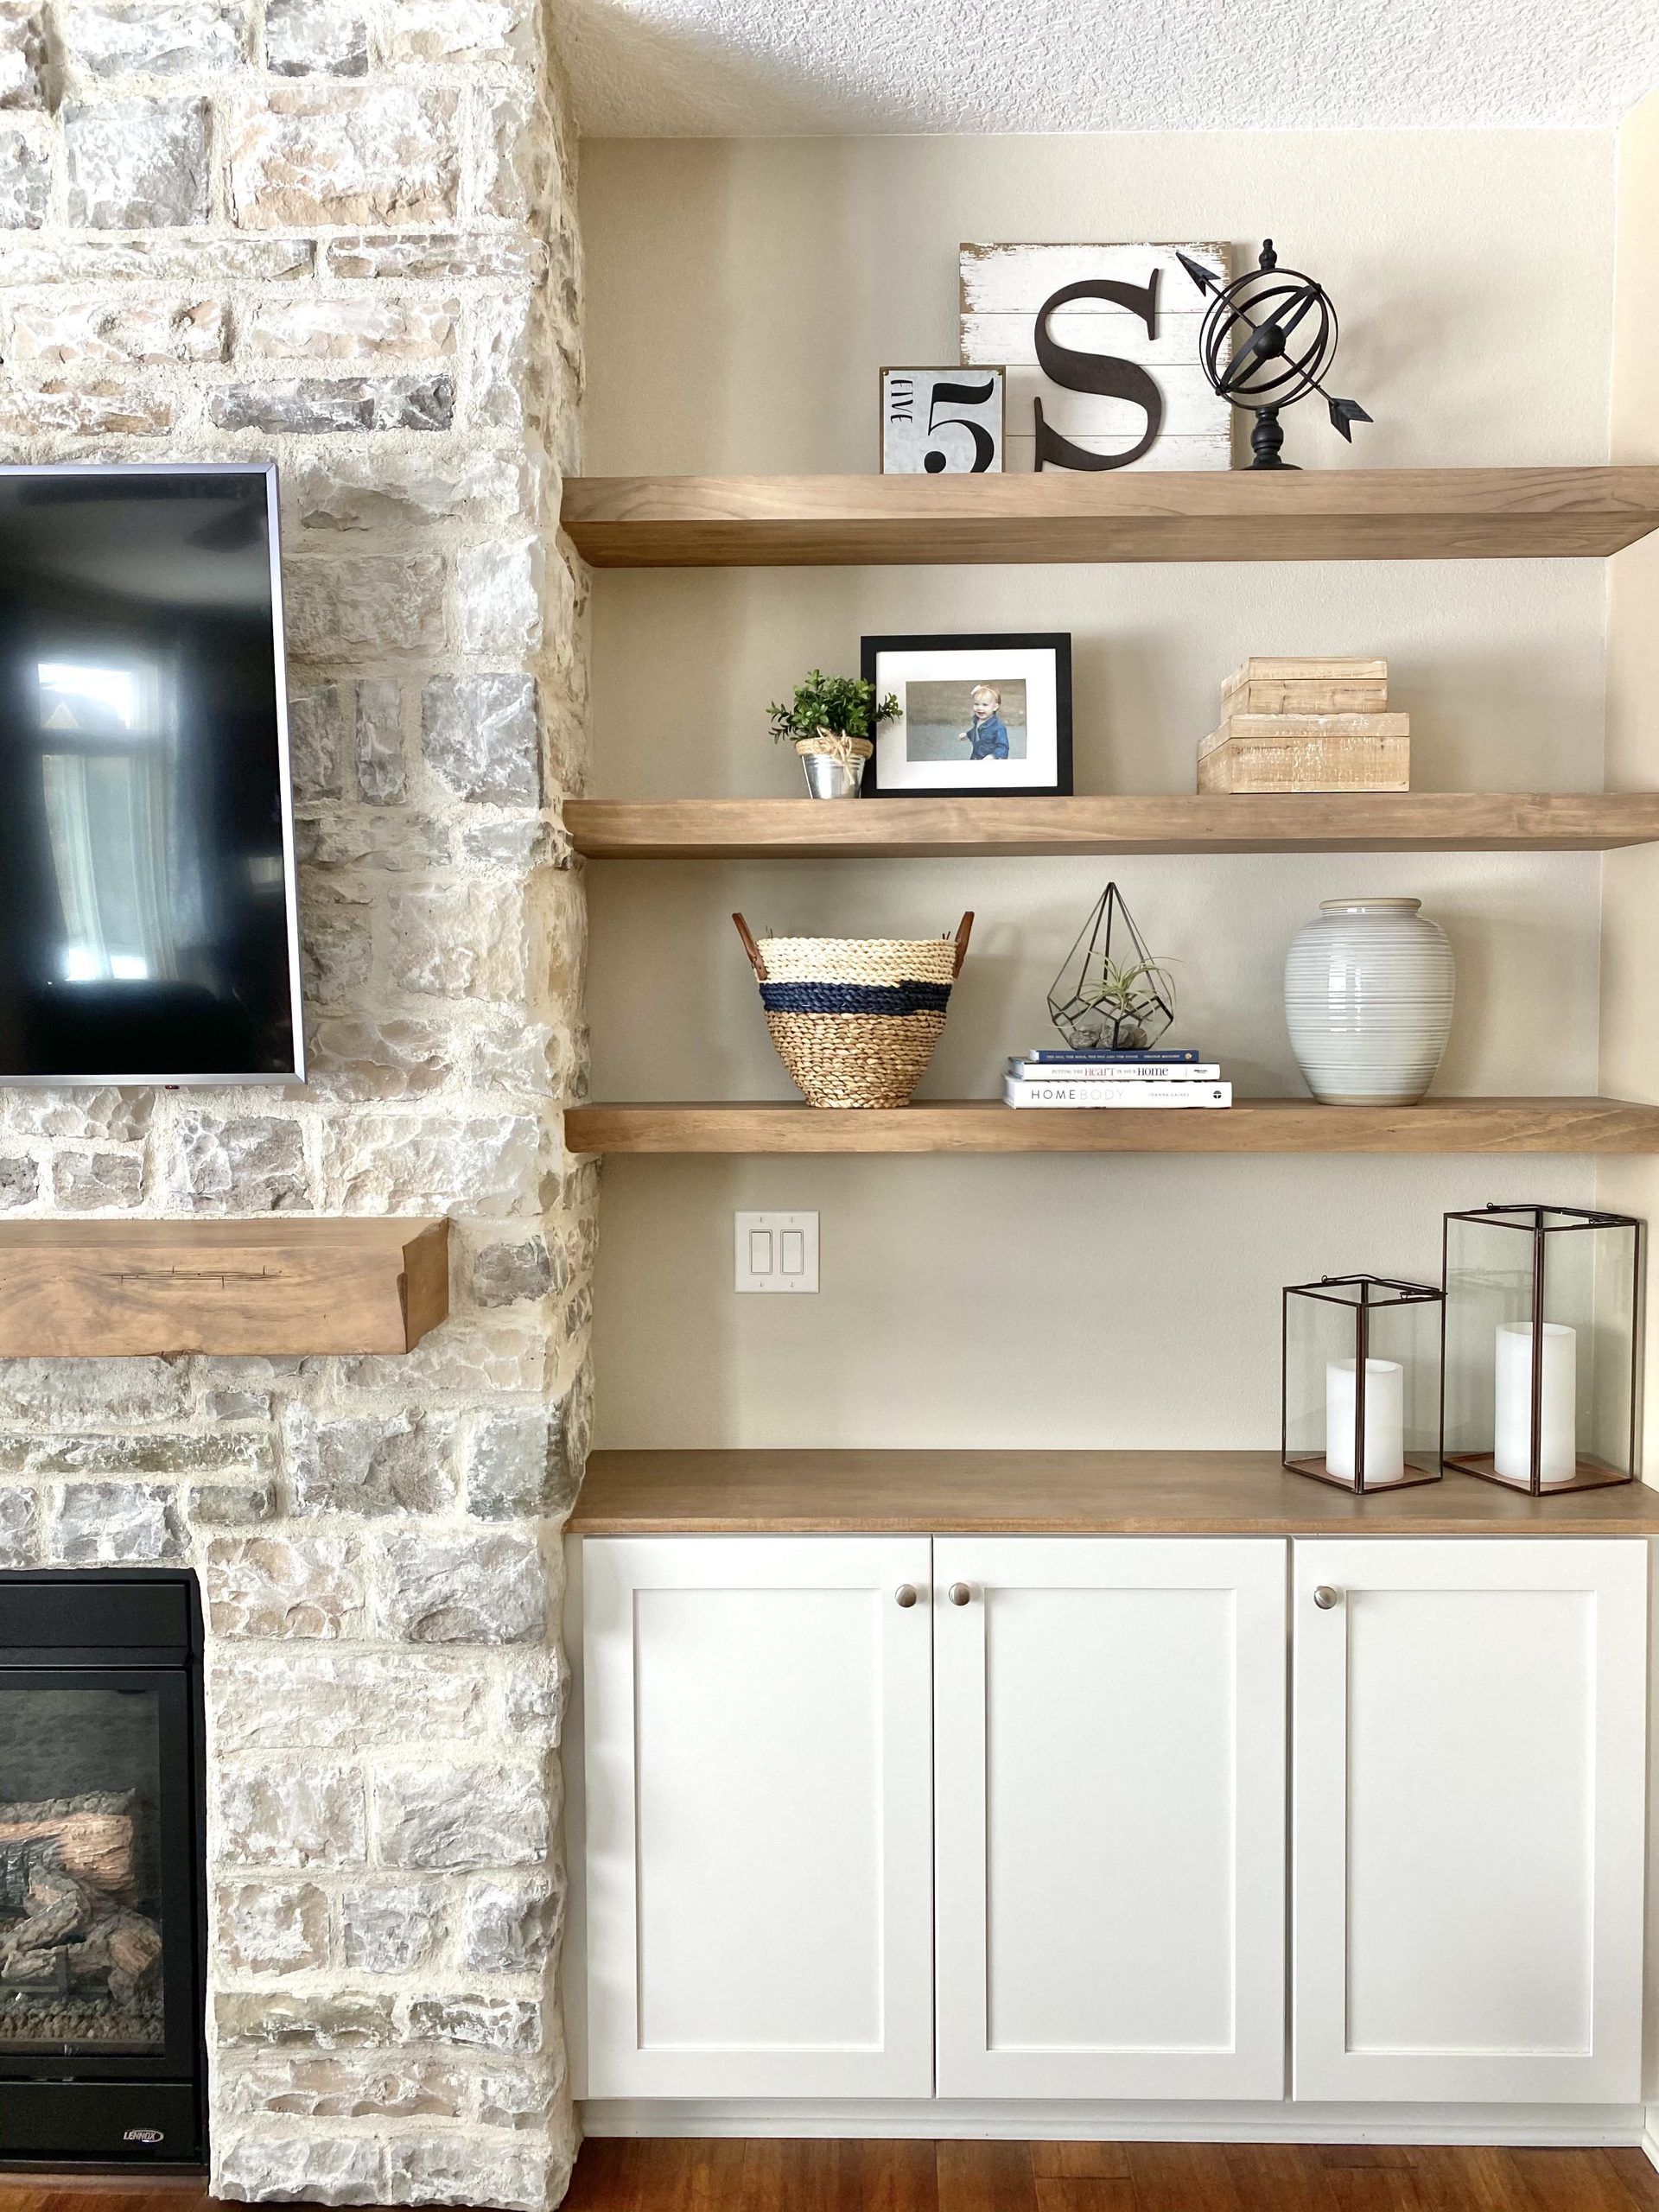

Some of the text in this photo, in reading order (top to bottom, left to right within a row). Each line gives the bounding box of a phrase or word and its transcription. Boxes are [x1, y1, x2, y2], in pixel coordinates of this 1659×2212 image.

[890, 379, 914, 424] FIVE
[1034, 268, 1162, 472] S
[924, 377, 995, 474] 5
[123, 2131, 156, 2140] LENNOX
